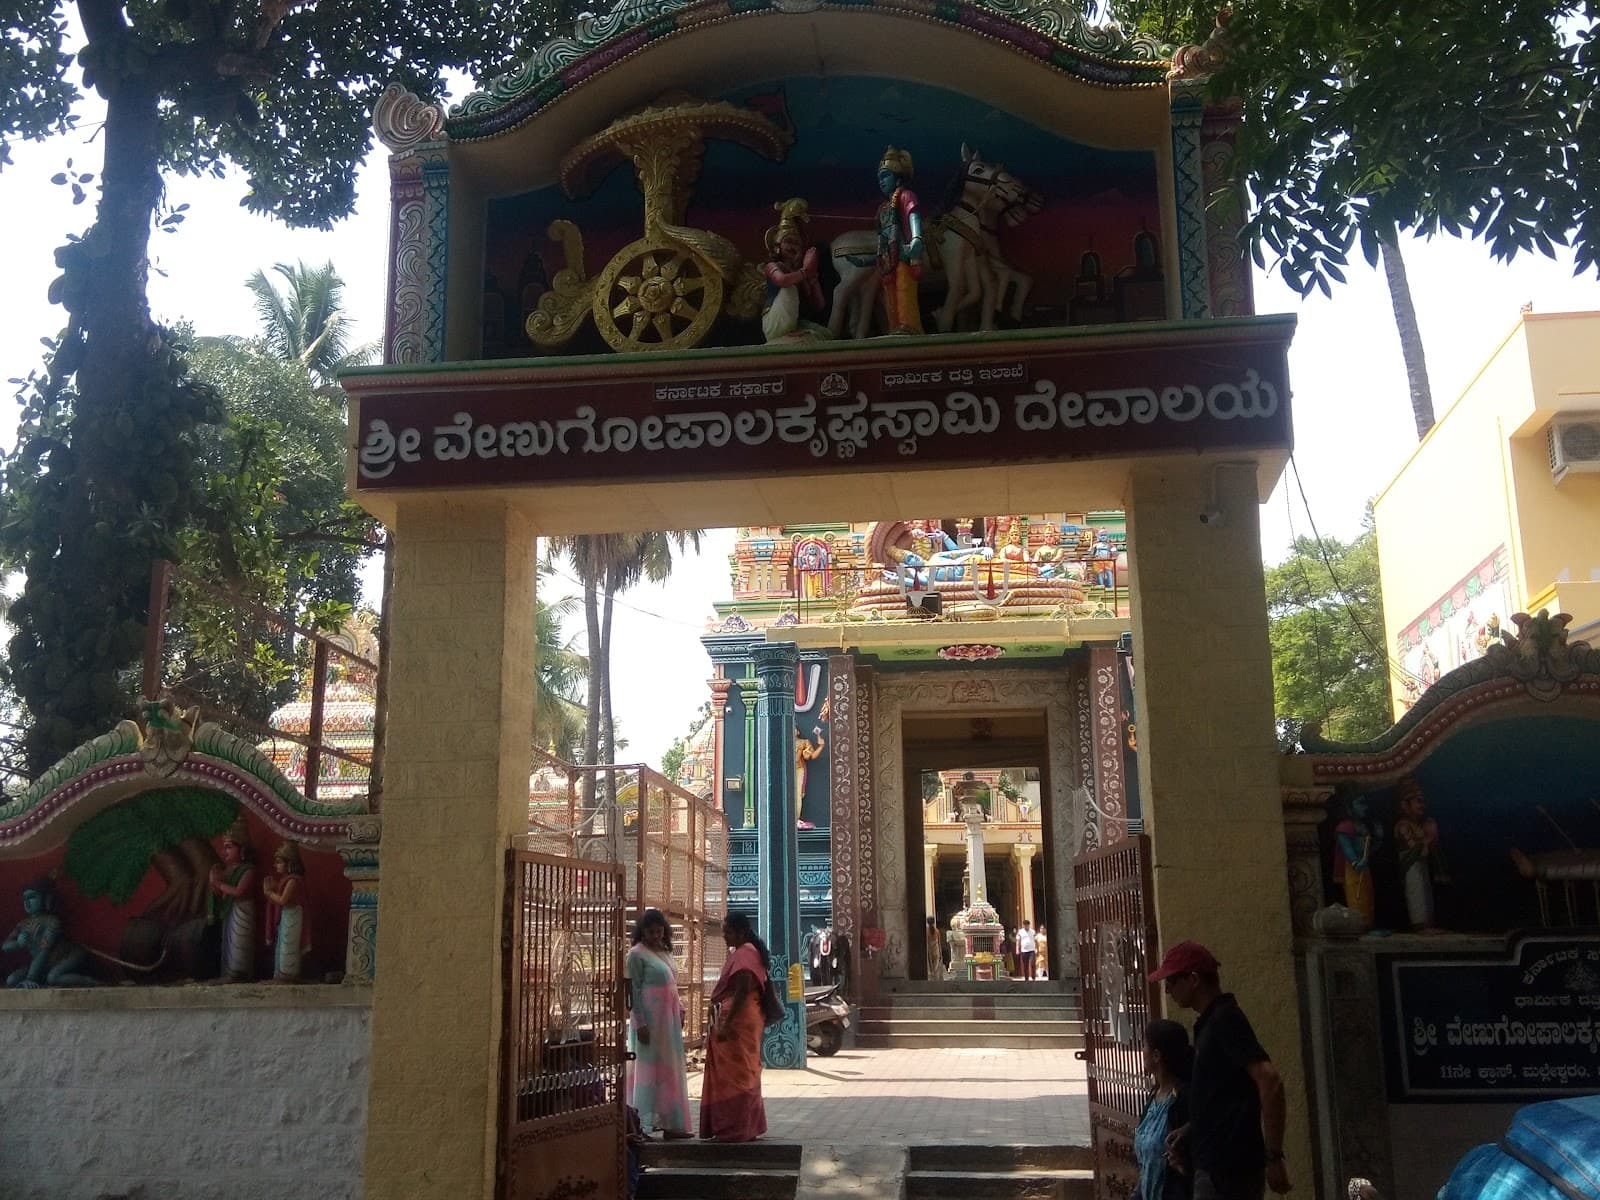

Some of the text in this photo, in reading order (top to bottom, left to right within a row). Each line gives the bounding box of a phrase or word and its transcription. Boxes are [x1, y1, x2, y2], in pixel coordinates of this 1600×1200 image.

[655, 380, 784, 400] ಕರ್ನಾಟಕ ಸರ್ಕಾರ
[884, 370, 943, 386] ಧಾರ್ಮಿಕ
[359, 417, 422, 480] ಶ್ರೀ
[1014, 367, 1279, 431] ದೇವಾಲಯ
[1413, 1016, 1438, 1056] ಶ್ರೀ
